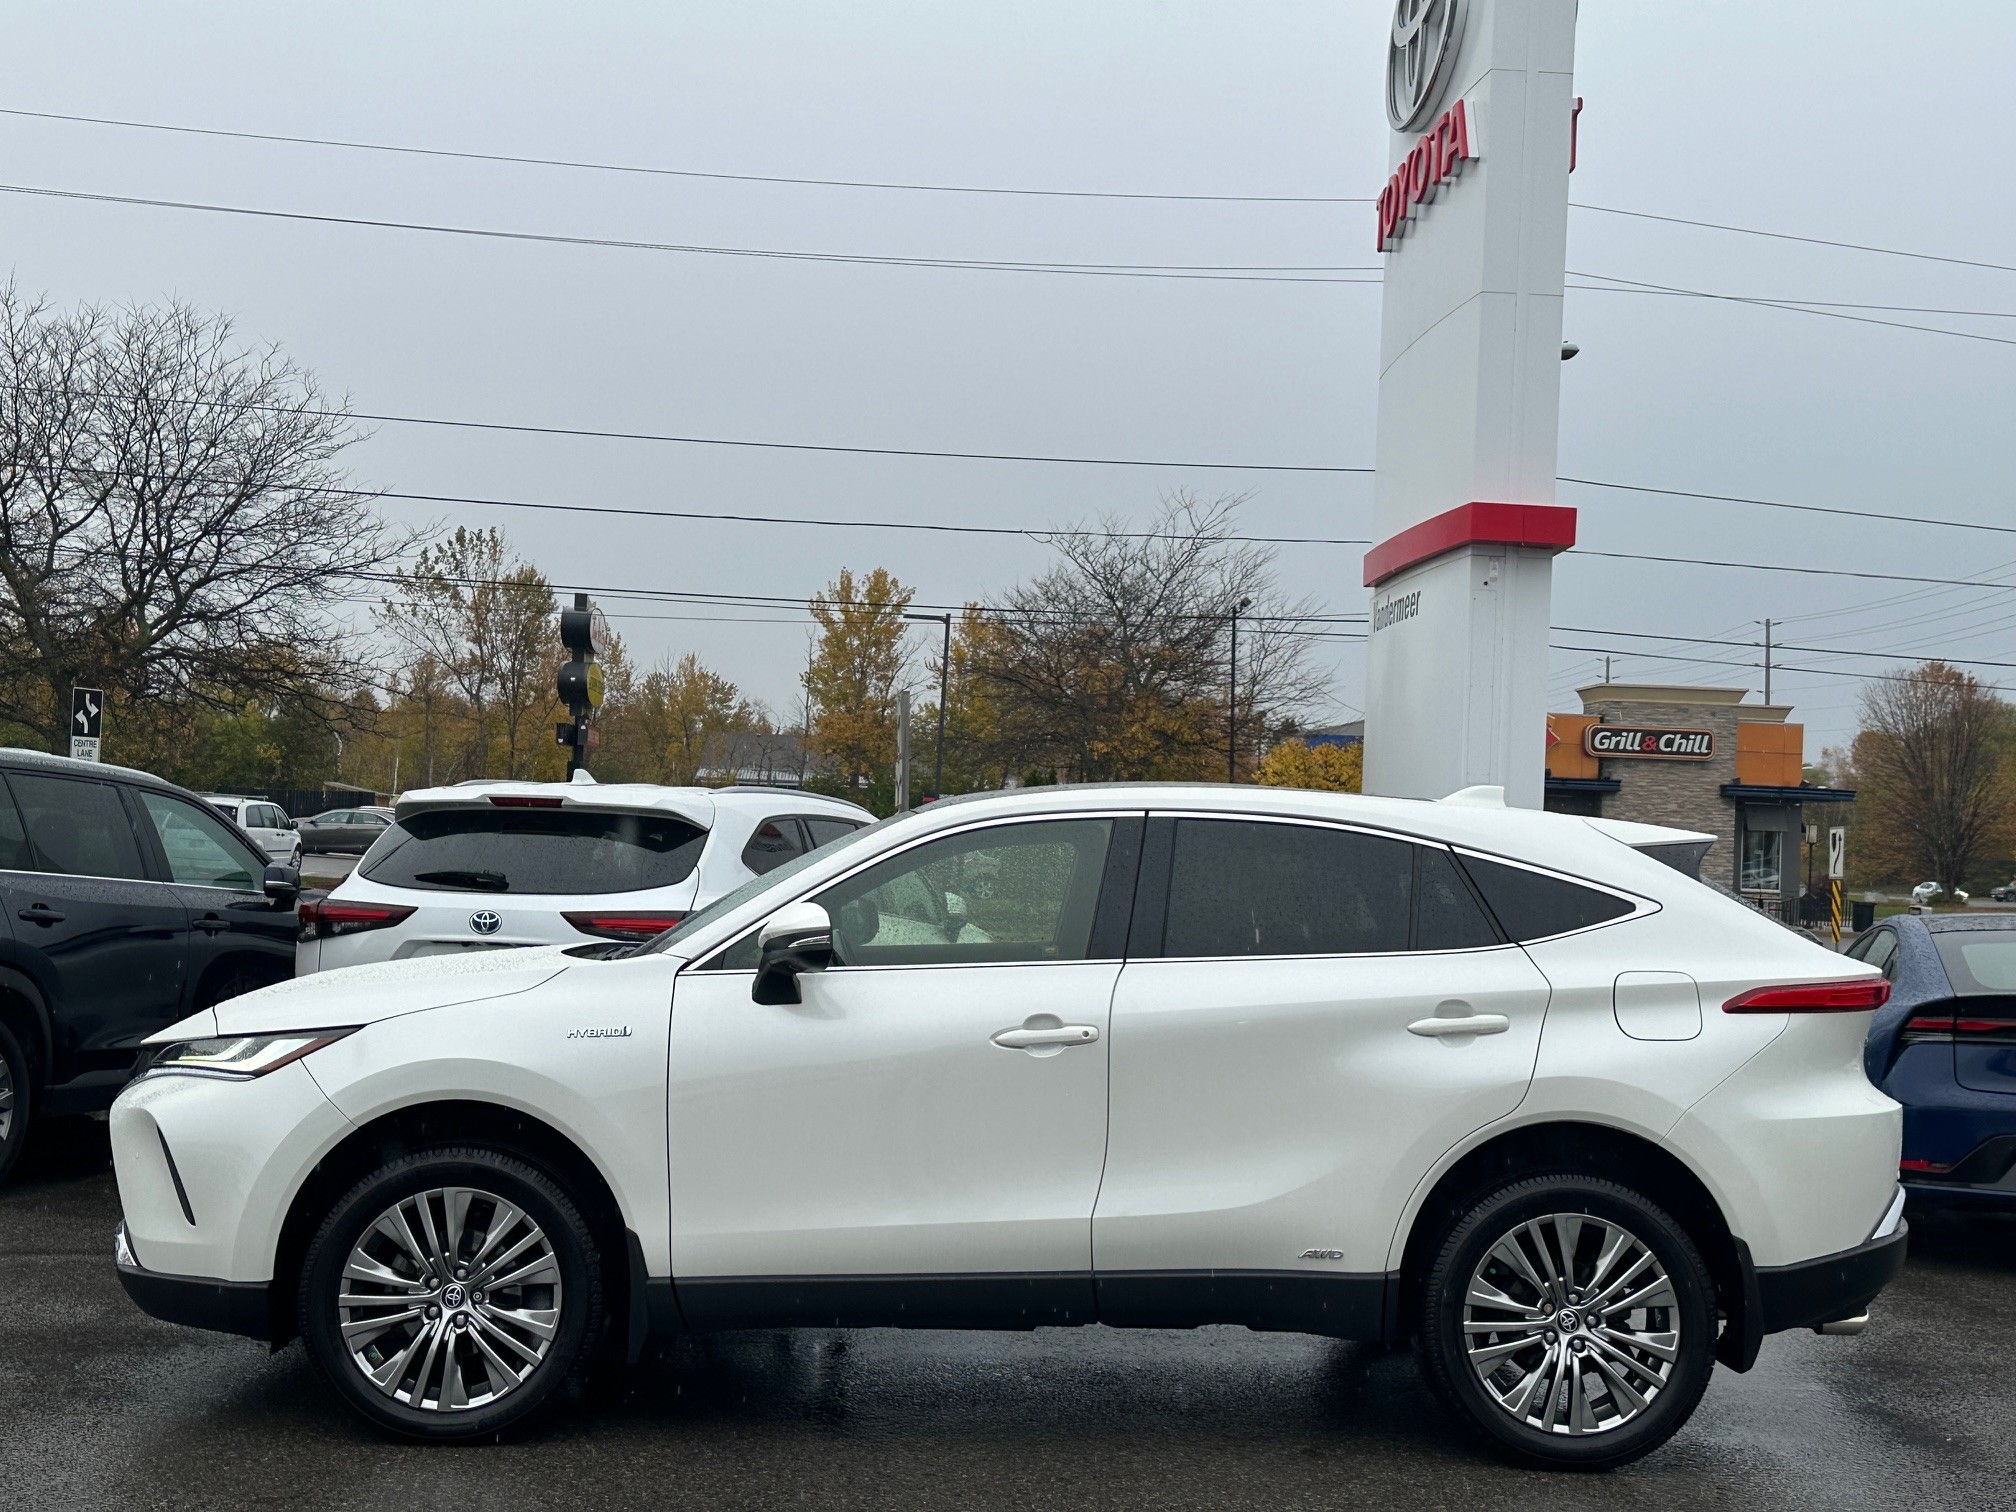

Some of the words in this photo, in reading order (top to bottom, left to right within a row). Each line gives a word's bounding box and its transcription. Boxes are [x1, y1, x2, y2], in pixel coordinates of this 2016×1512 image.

[1376, 98, 1470, 253] TOYOTA
[73, 739, 98, 749] CENTRE
[77, 749, 93, 758] LANE
[566, 1027, 622, 1039] HYBRID
[1297, 1248, 1345, 1259] AWD
